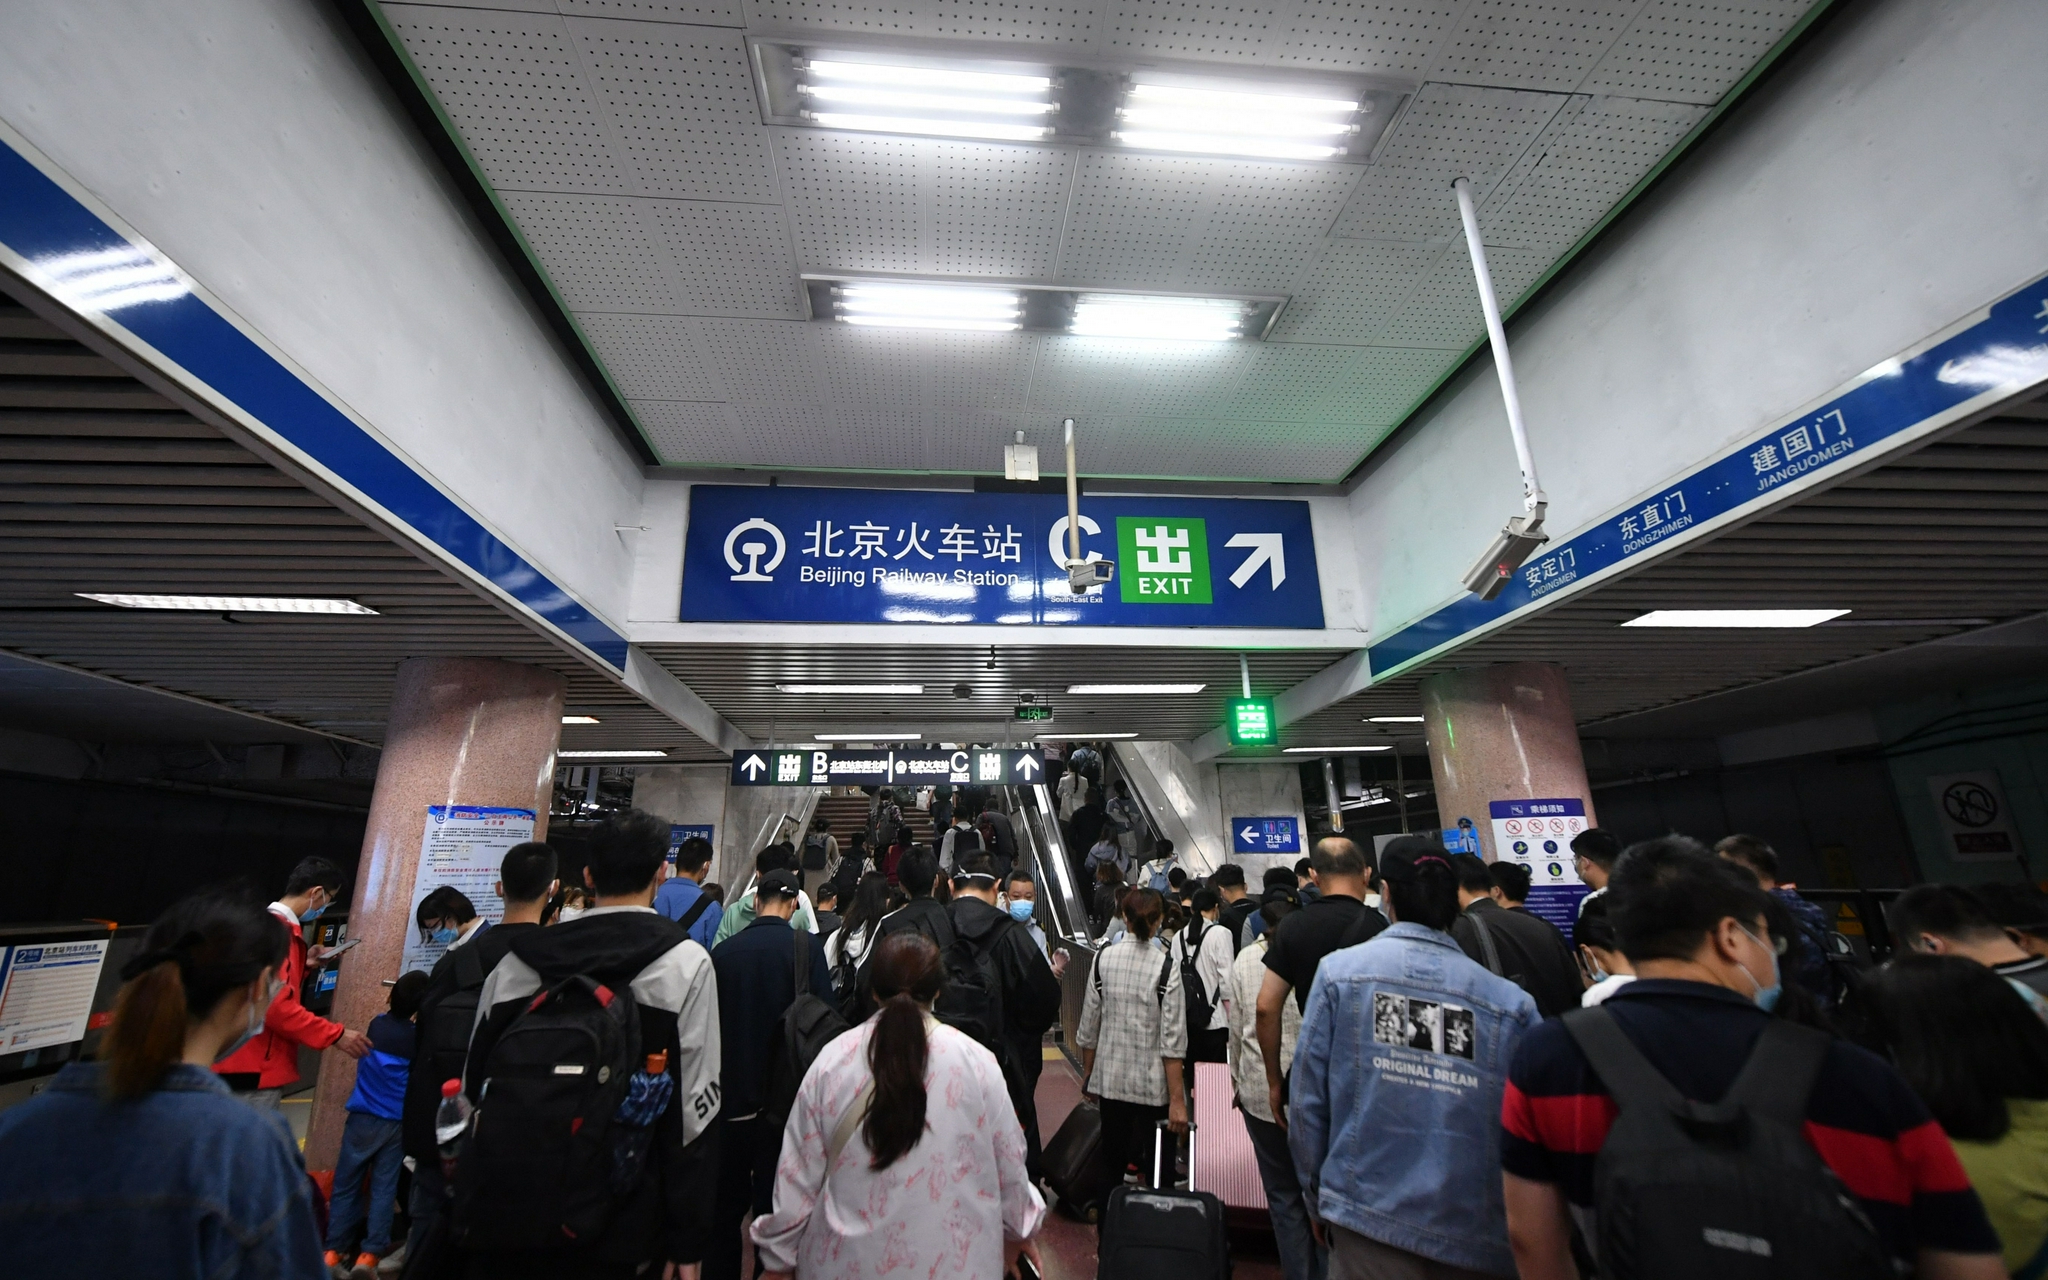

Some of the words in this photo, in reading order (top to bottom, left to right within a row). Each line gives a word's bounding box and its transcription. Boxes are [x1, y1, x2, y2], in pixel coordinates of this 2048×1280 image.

[1750, 409, 1847, 475] 建国门
[1757, 437, 1854, 491] JIANGUOMEN
[1618, 491, 1687, 540] 东直门
[801, 520, 1023, 563] 北京火车站
[1048, 514, 1103, 573] C
[1135, 526, 1192, 573] 出
[1623, 514, 1693, 554] DONGZHIMEN
[800, 566, 866, 587] Beijing
[872, 567, 948, 587] Railway
[953, 569, 1019, 586] Station
[1525, 547, 1576, 589] 安定门
[1531, 570, 1577, 598] ANDINGMEN
[1138, 577, 1193, 595] EXIT
[777, 773, 800, 782] EXIT
[812, 751, 828, 774] B
[951, 751, 969, 773] C
[1265, 834, 1291, 844] 卫生间
[17, 951, 27, 963] 2
[1372, 1056, 1433, 1079] ORIGINAL
[1433, 1068, 1479, 1088] DREAM
